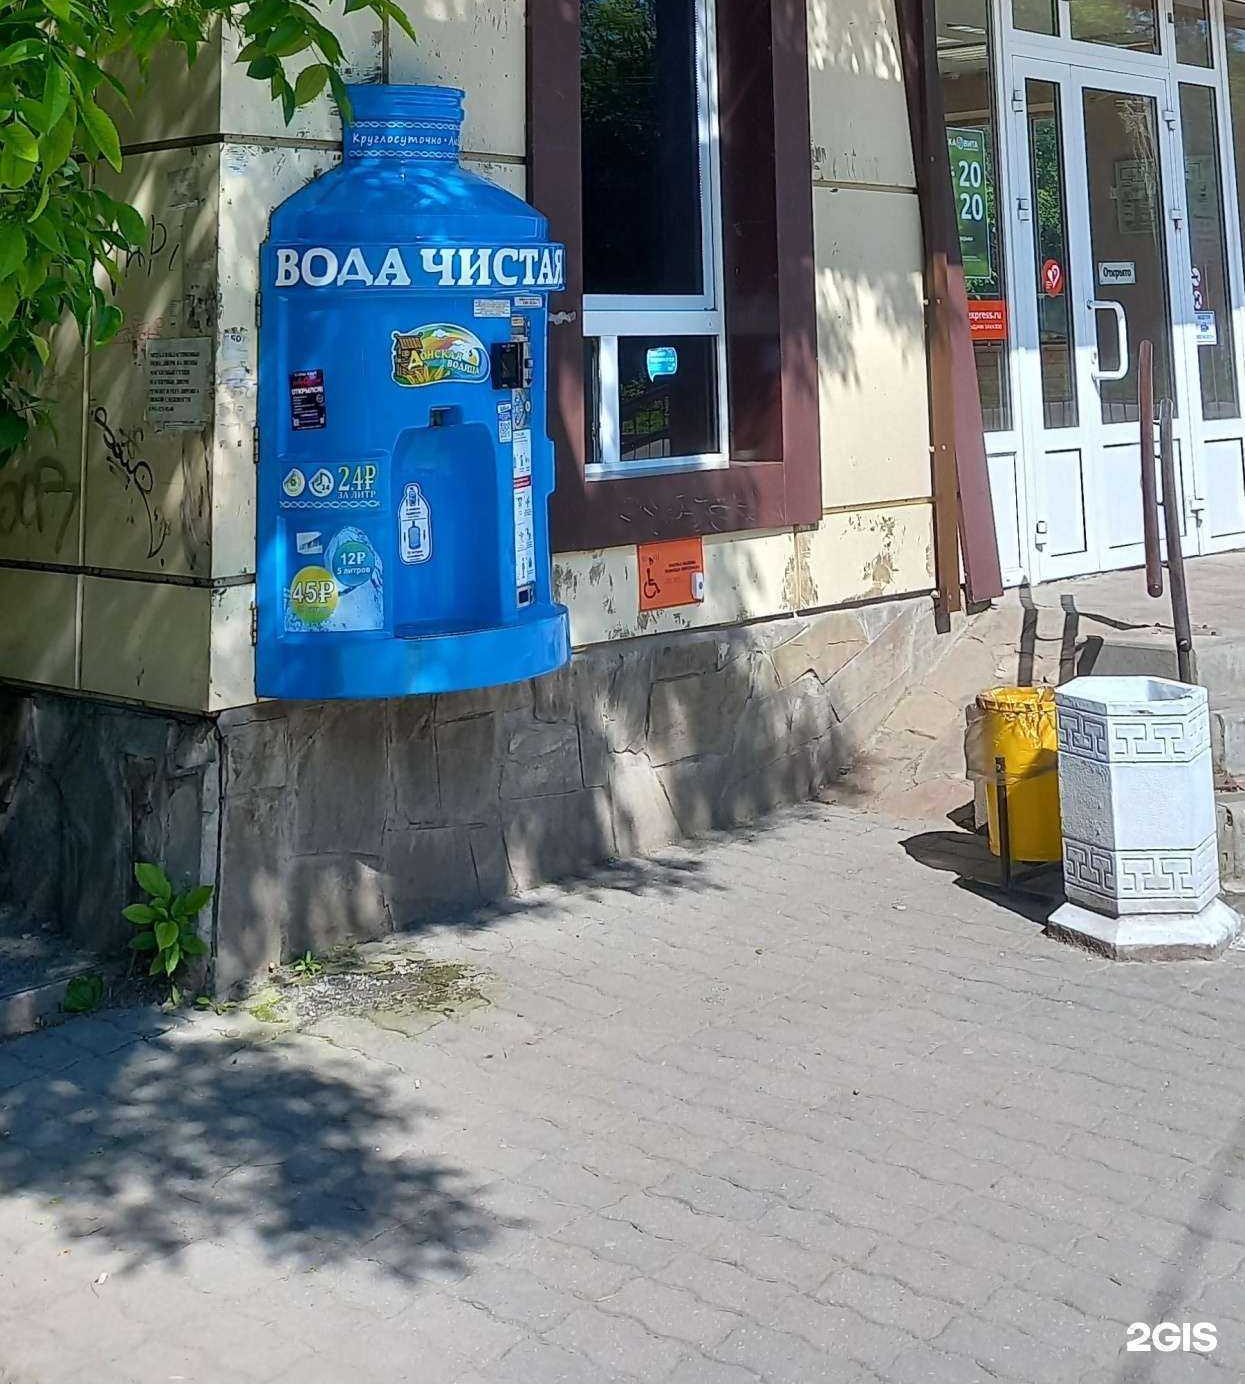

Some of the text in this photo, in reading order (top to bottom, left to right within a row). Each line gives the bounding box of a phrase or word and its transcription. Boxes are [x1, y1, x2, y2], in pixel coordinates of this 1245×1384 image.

[959, 160, 981, 188] 20
[960, 193, 983, 221] 20
[274, 248, 566, 287] ВОДА ЧИСТАЯ
